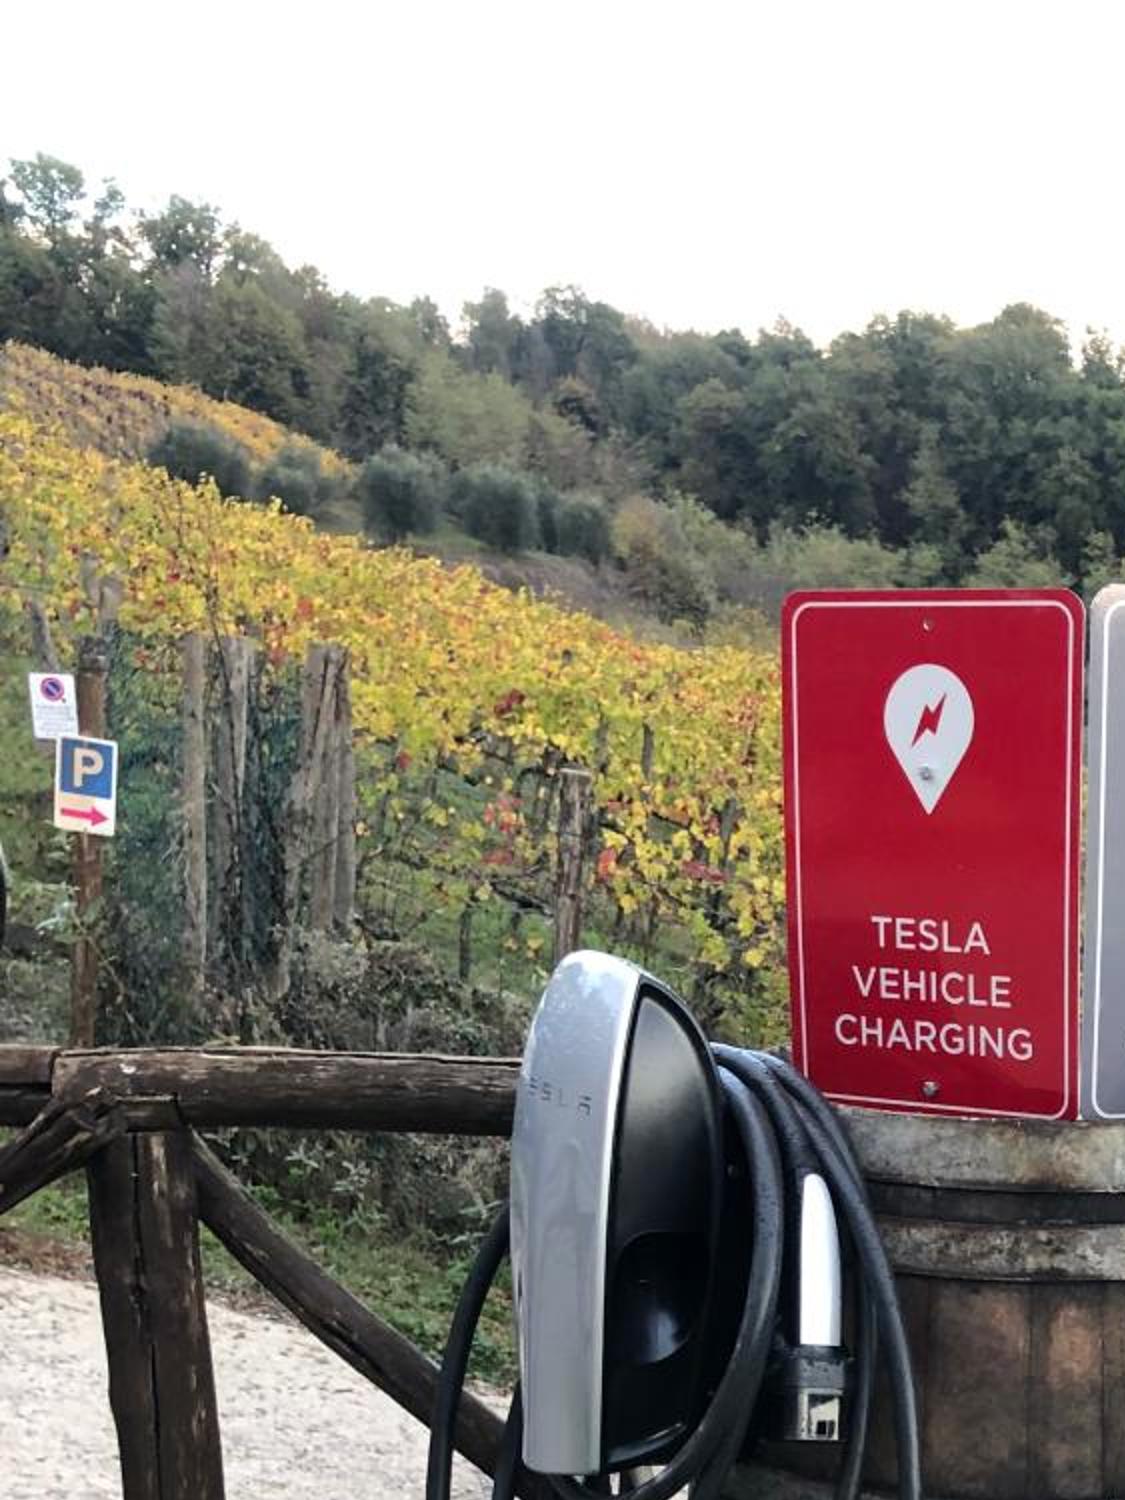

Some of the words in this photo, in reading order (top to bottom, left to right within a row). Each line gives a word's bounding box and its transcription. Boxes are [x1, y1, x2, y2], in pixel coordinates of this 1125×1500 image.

[73, 748, 103, 788] P
[871, 916, 990, 955] TESLA
[852, 966, 1011, 1008] VEHICLE
[835, 1013, 1033, 1061] CHARGING
